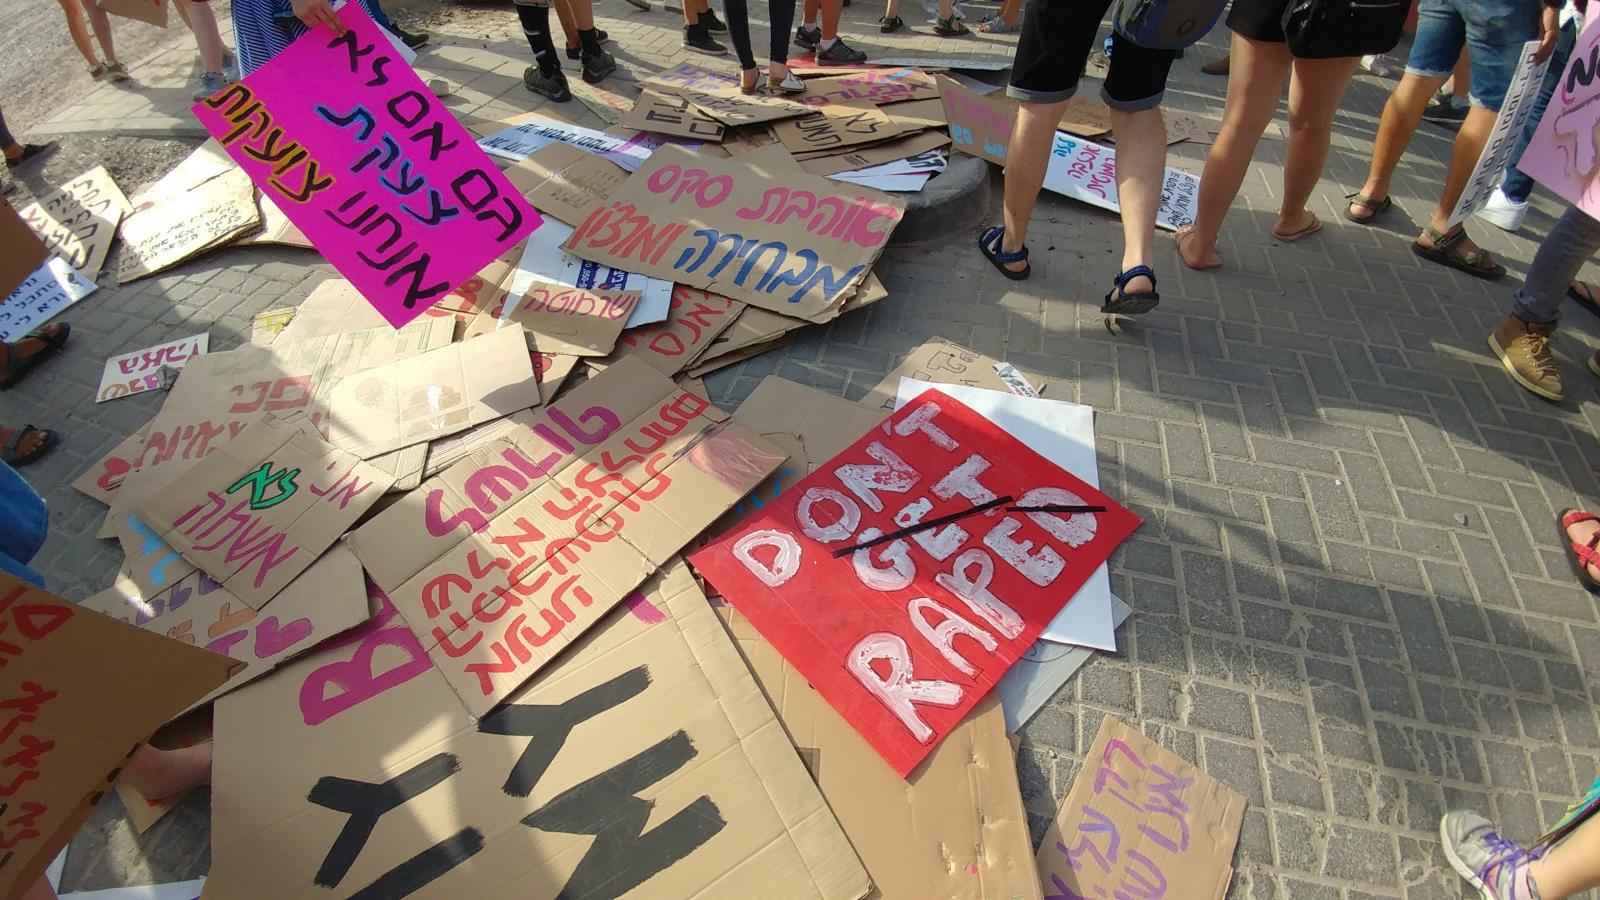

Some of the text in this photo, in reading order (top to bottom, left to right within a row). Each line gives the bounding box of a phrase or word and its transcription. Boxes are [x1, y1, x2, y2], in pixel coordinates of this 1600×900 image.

[836, 111, 884, 134] לא
[1567, 45, 1600, 93] N
[205, 84, 335, 204] צועקות
[317, 104, 460, 226] צעקת
[326, 30, 523, 244] גם אם לא
[646, 163, 732, 208] סקס
[324, 191, 451, 310] אנחנו
[566, 201, 868, 305] מבחירה ומרצון
[735, 186, 902, 248] אוהבת
[523, 289, 641, 321] שרמוטה
[226, 460, 304, 512] לא
[310, 461, 373, 511] אני
[421, 517, 546, 620] שלא
[542, 391, 710, 520] הצלחתם
[425, 405, 622, 538] לשרוף
[850, 453, 995, 593] GET
[172, 490, 299, 590] אשמה
[430, 452, 673, 658] המכשפות
[463, 574, 594, 696] אנחנו
[844, 486, 1100, 745] RAPED
[472, 663, 729, 900] MY
[1093, 737, 1148, 813] רק
